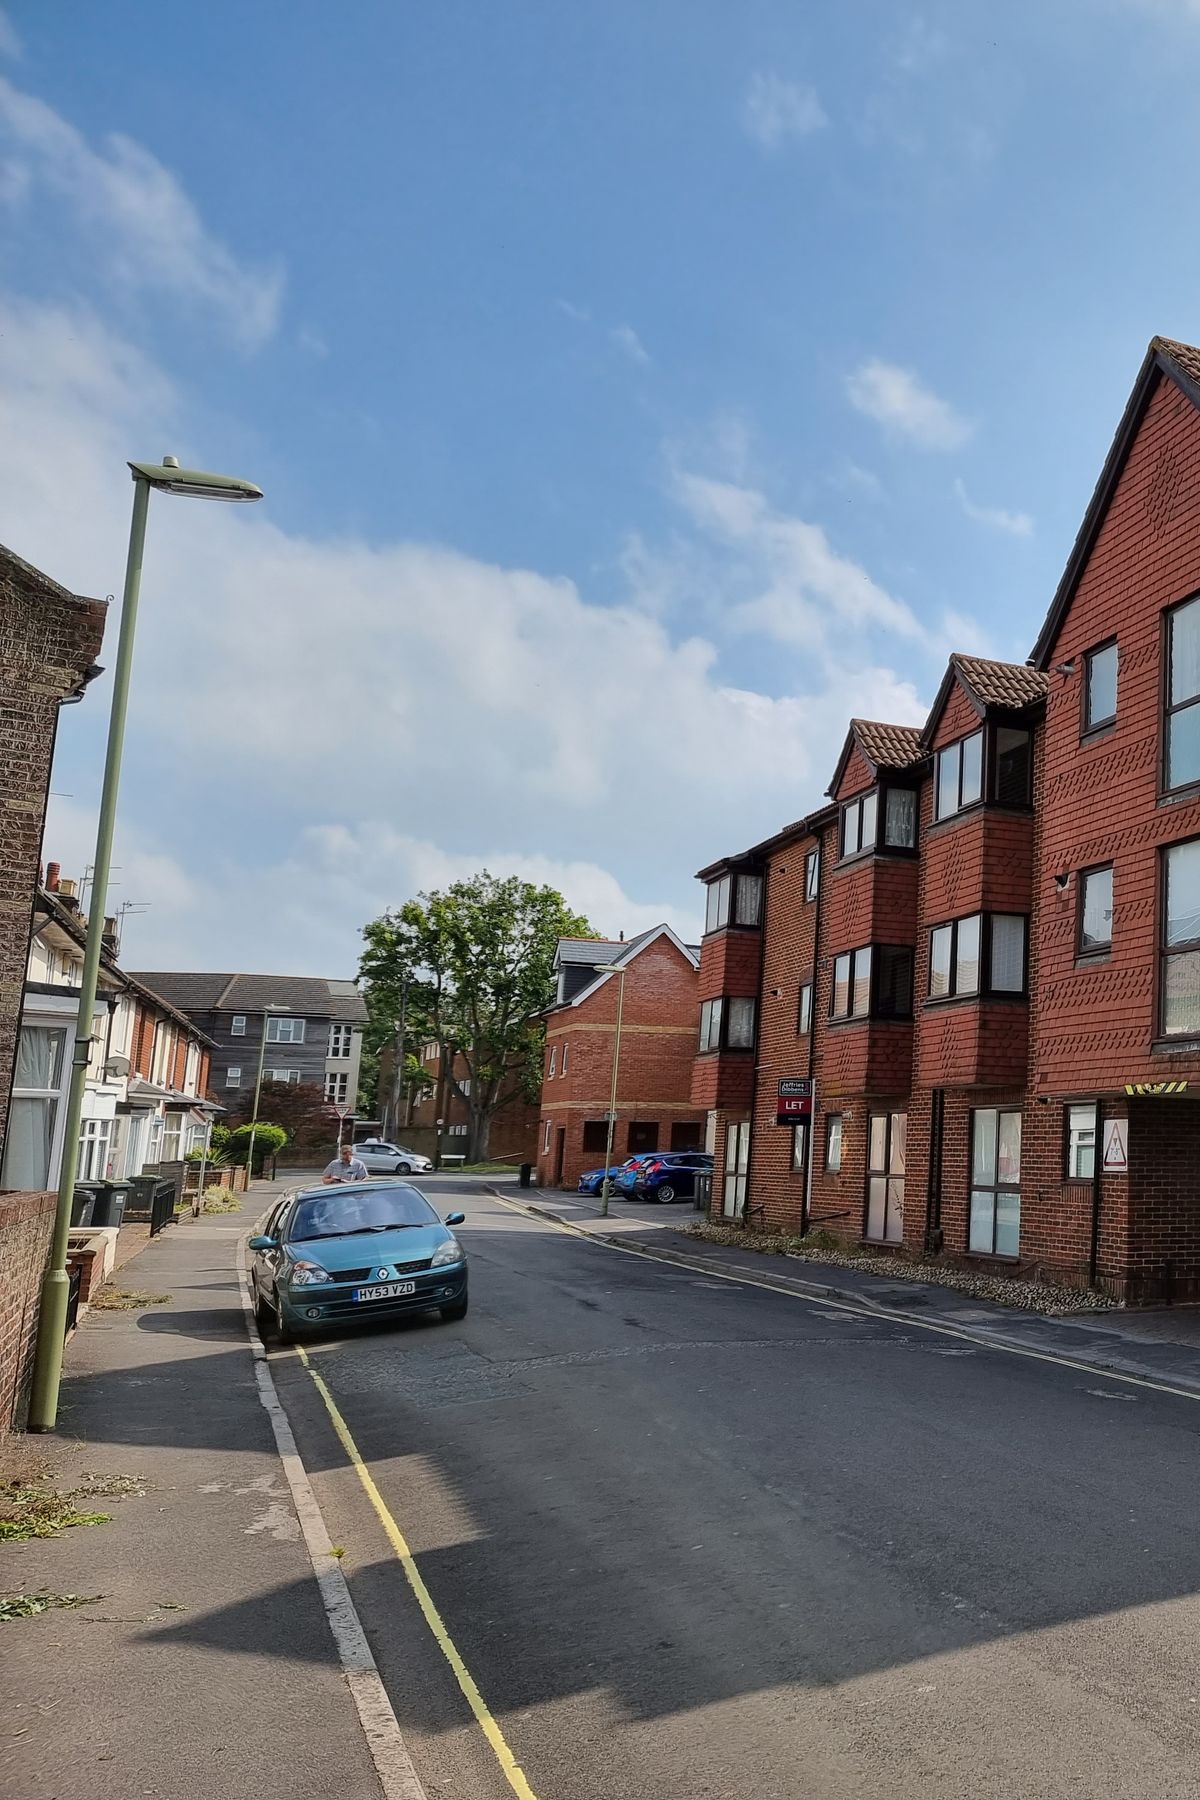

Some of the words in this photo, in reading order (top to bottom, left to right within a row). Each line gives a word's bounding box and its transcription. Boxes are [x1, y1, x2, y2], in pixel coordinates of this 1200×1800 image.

[785, 1101, 804, 1110] LET
[360, 1287, 388, 1300] HY53
[392, 1283, 413, 1294] VZD
